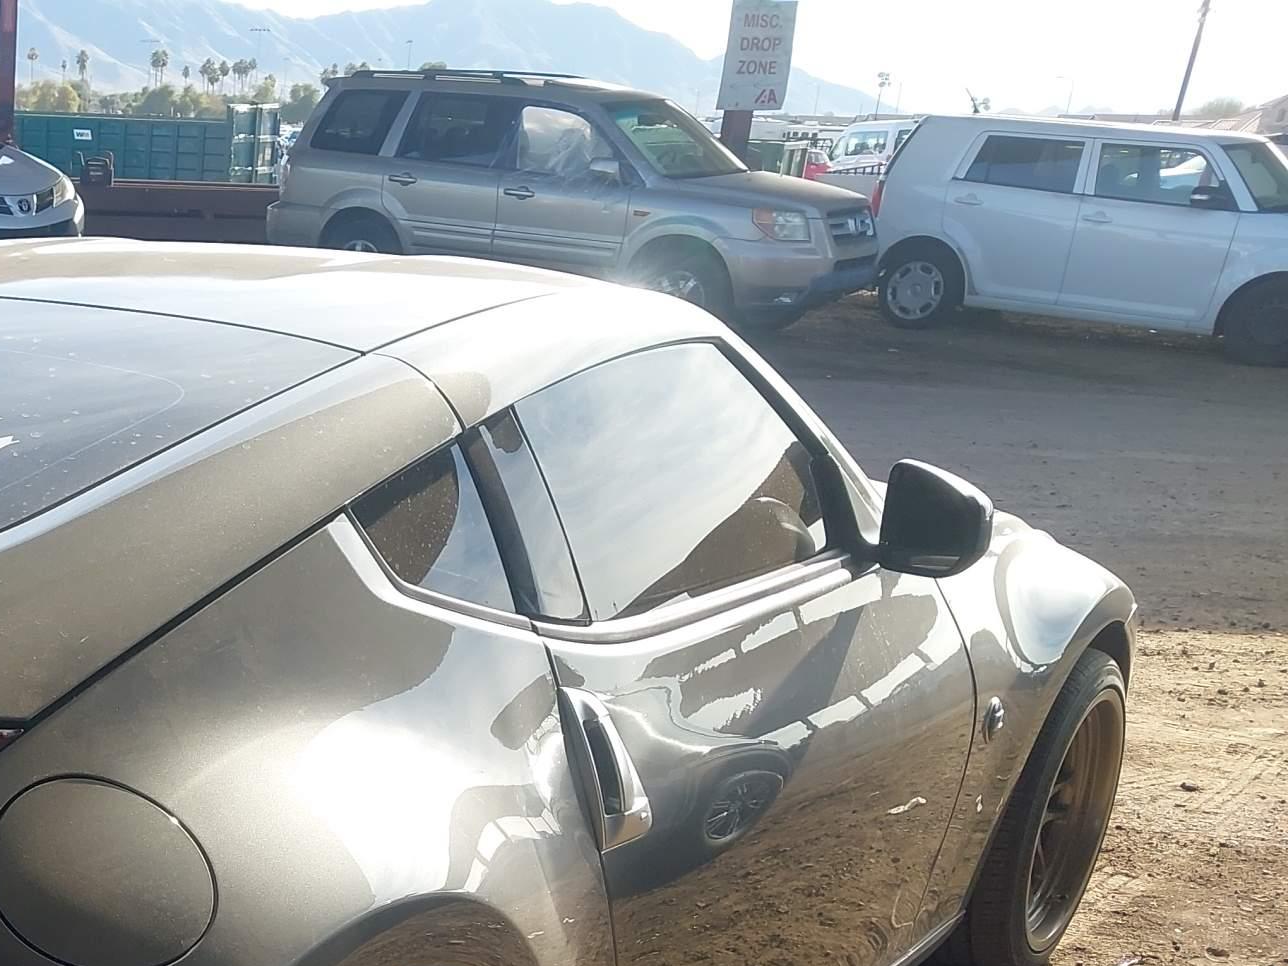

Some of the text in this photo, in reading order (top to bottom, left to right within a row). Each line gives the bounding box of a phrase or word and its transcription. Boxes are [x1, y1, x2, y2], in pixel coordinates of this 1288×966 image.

[743, 13, 783, 29] MISC.
[740, 37, 782, 52] DROP
[736, 60, 778, 75] ZONE
